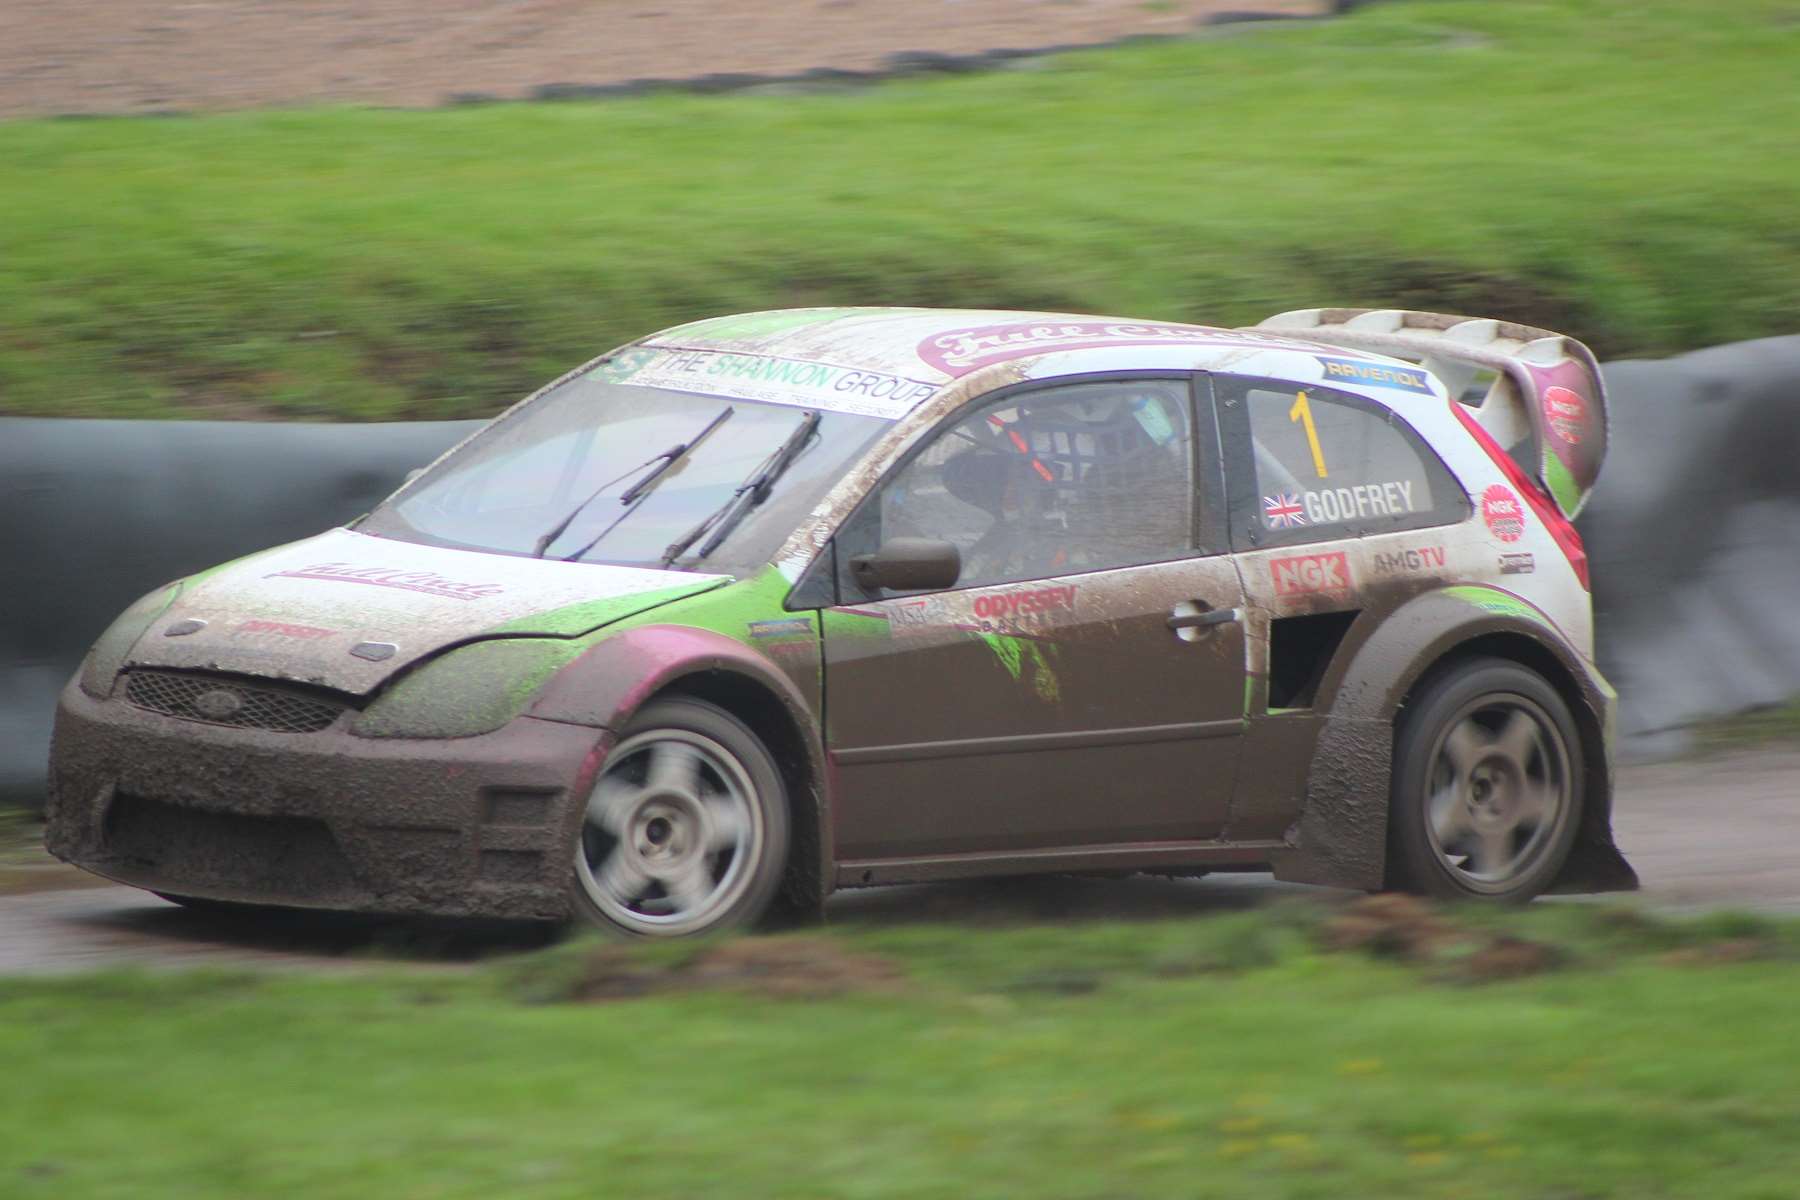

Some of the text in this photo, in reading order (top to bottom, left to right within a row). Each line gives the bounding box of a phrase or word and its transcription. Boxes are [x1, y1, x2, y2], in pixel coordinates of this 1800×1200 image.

[656, 350, 714, 372] THE
[706, 354, 839, 388] SHANNON
[834, 371, 937, 403] GROUP
[1289, 391, 1328, 479] 1
[1304, 480, 1414, 523] GODFREY
[1487, 501, 1516, 514] NGK
[1278, 556, 1346, 592] NGK
[1375, 546, 1446, 574] AMGTV
[973, 584, 1077, 618] ODYSSEY
